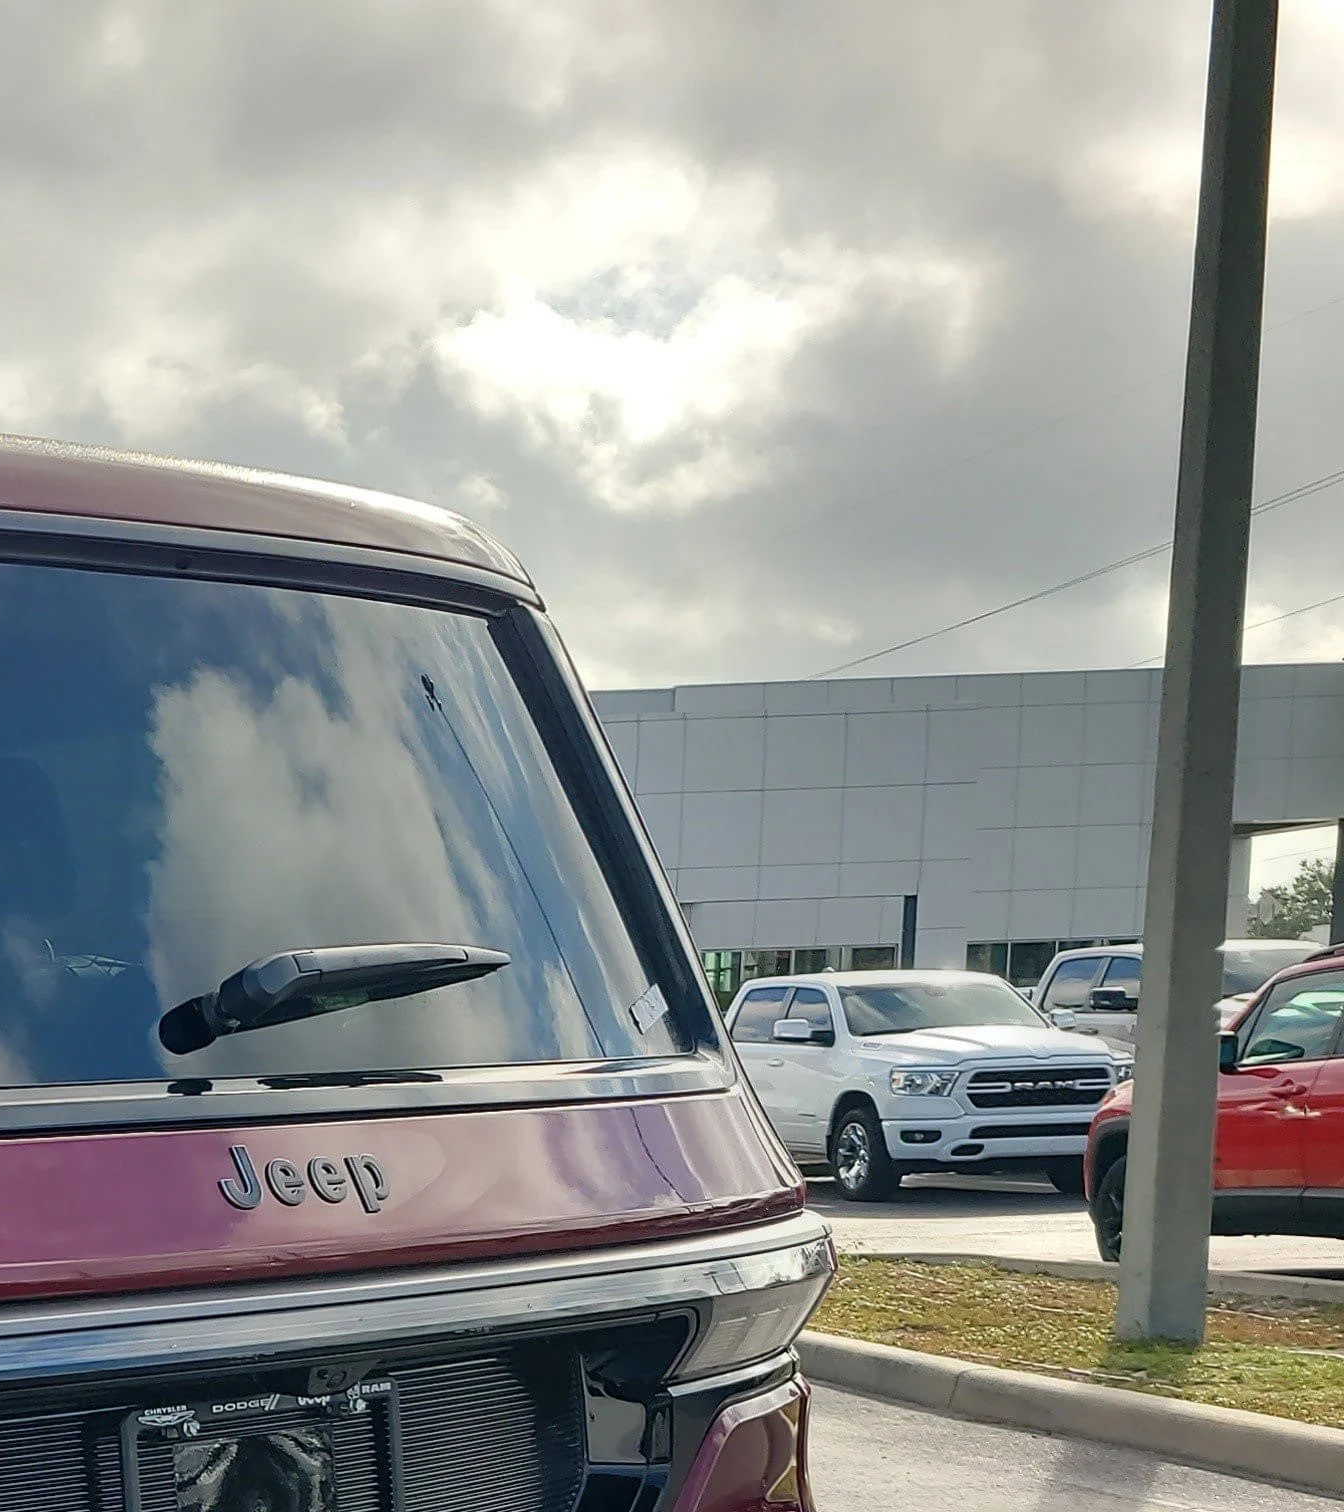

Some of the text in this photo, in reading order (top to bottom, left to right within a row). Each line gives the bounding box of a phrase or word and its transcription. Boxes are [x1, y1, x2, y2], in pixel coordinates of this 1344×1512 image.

[217, 1144, 391, 1214] Jeep
[144, 1404, 187, 1416] CHRYSLER
[212, 1398, 272, 1413] DODGE
[361, 1382, 392, 1394] RAM
